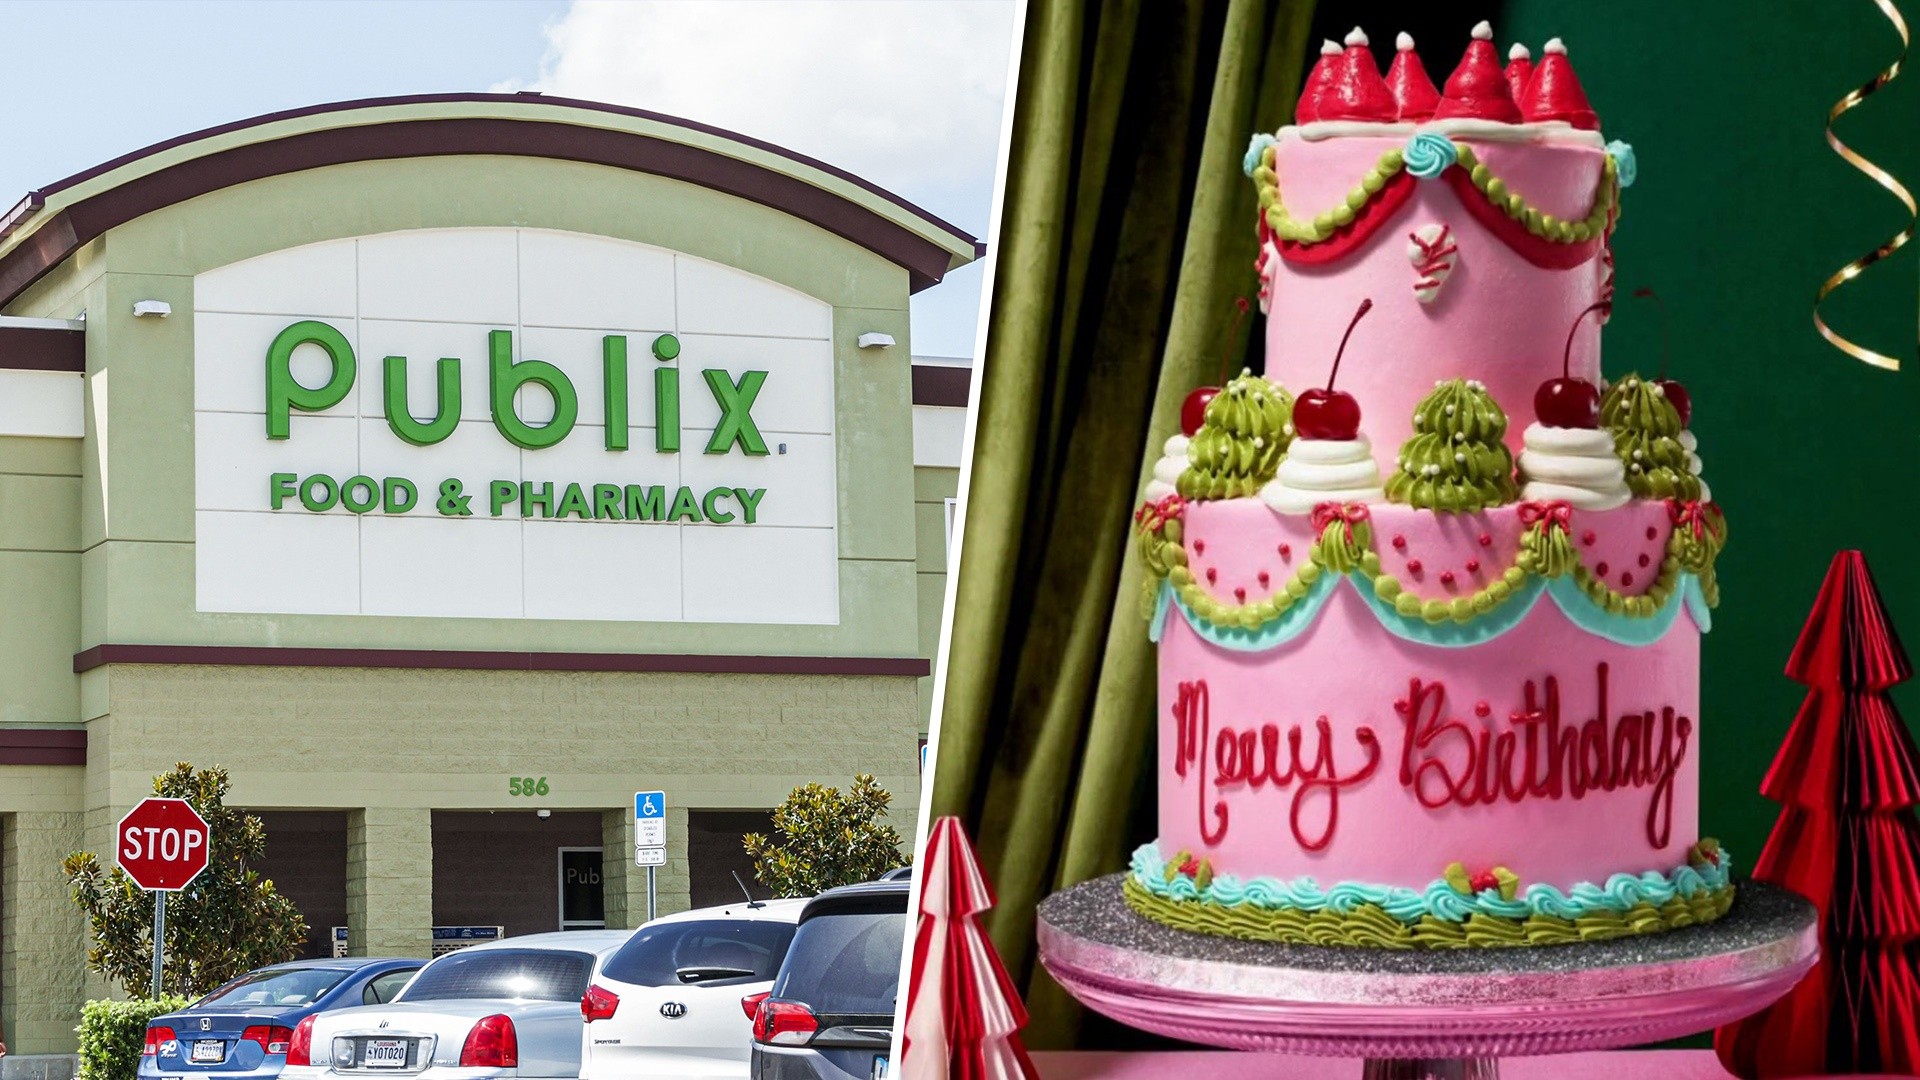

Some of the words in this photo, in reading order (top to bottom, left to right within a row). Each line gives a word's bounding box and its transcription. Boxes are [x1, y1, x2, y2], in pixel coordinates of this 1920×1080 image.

[265, 320, 770, 456] Publix
[270, 473, 418, 515] FOOD
[436, 478, 473, 516] &
[490, 480, 767, 524] PHARMACY
[1172, 679, 1382, 852] Merry
[1394, 662, 1693, 849] Birthday
[509, 776, 549, 796] 586
[123, 826, 203, 862] STOP
[566, 867, 603, 885] Pub
[662, 1004, 682, 1015] KIA
